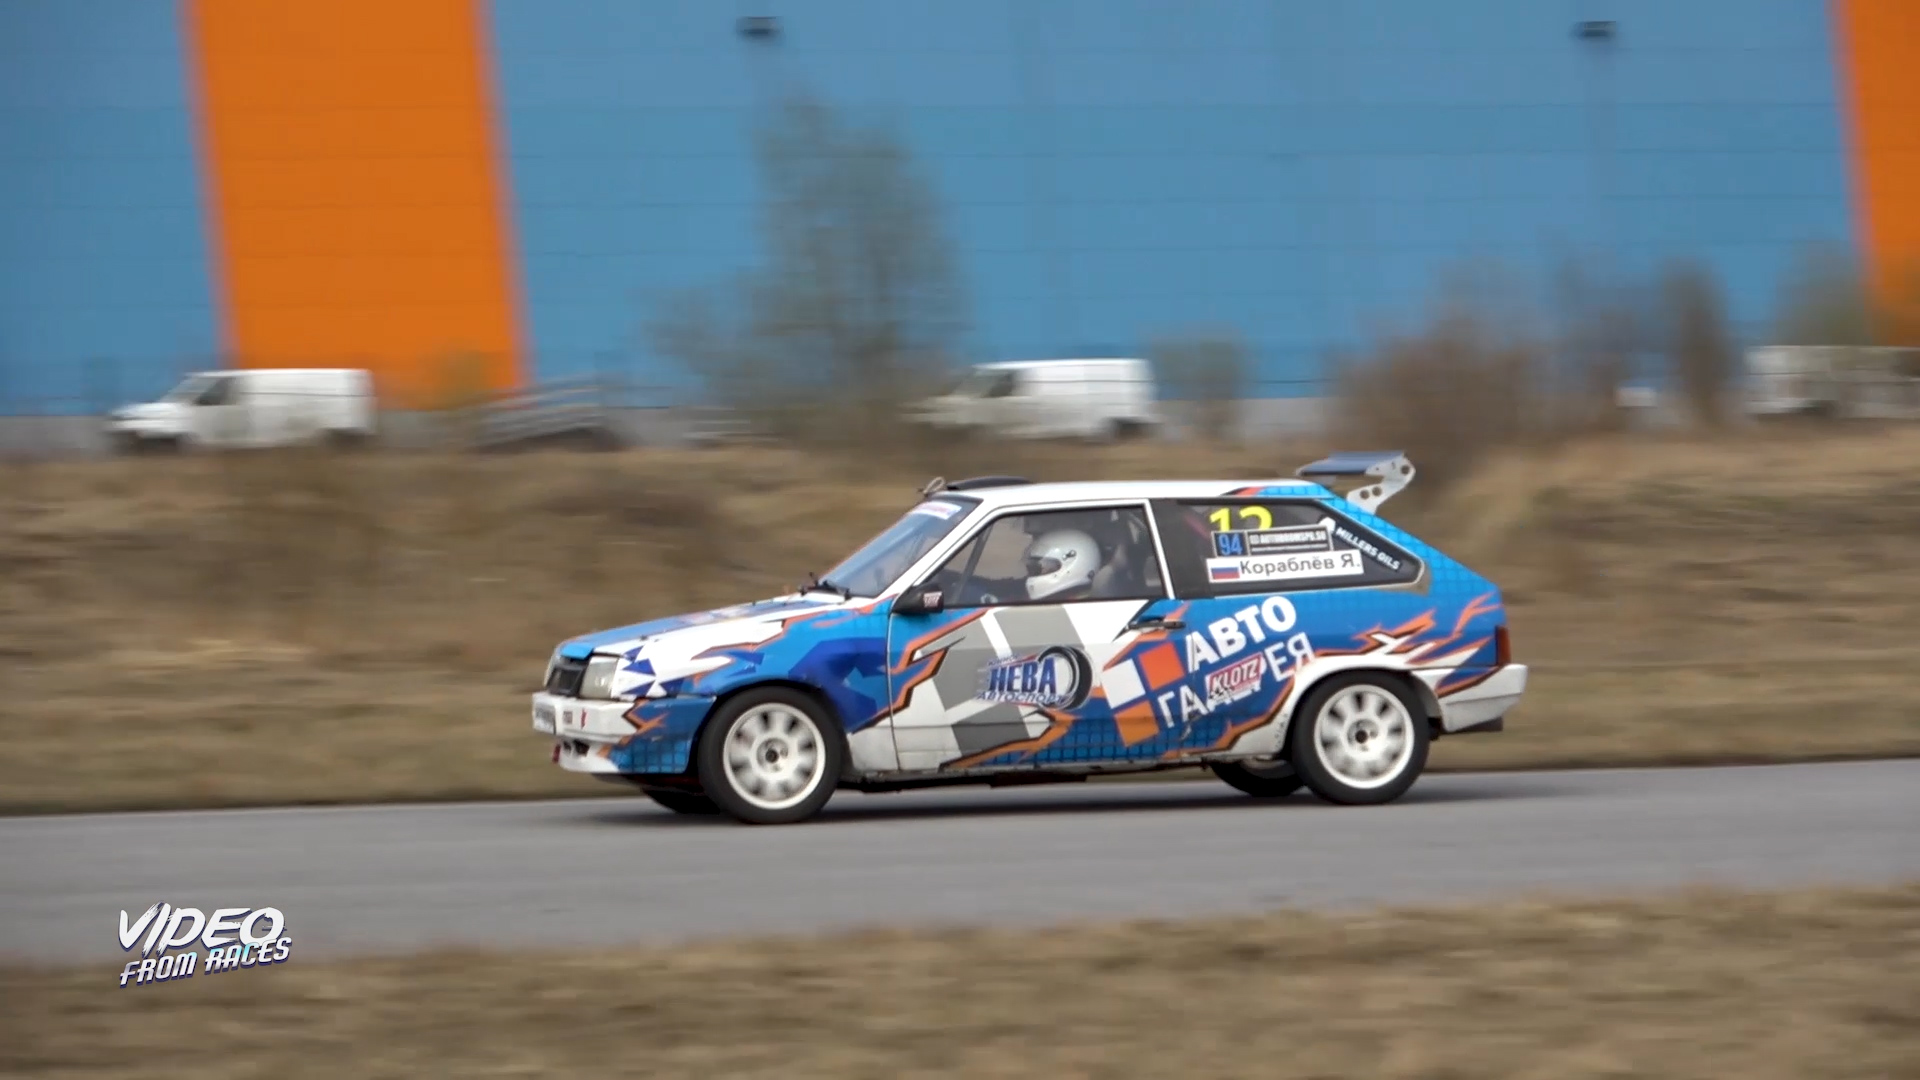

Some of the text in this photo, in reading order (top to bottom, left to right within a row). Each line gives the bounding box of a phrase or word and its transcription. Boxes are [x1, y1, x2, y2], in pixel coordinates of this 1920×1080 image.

[1218, 533, 1243, 556] 94
[1335, 526, 1401, 570] MILLERS OILS
[1240, 553, 1361, 576] Кораблёв Я.
[1185, 595, 1297, 674] АВТО
[987, 657, 1057, 694] НЕВА
[1157, 631, 1316, 729] ГАЕЯ
[1211, 658, 1259, 692] KLOTZ
